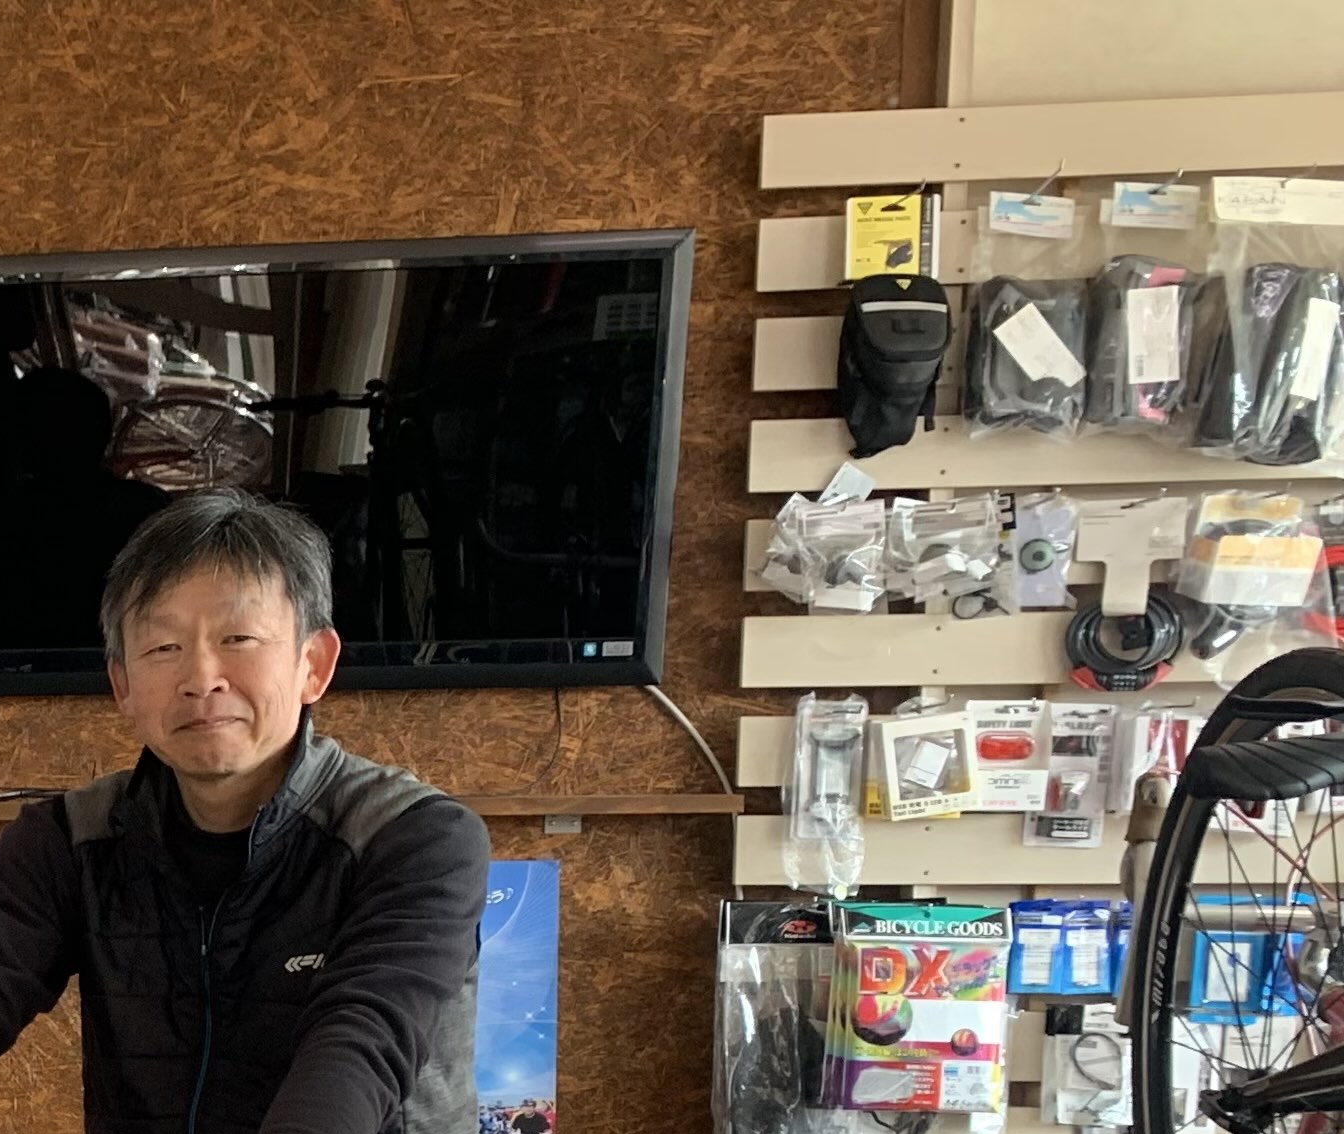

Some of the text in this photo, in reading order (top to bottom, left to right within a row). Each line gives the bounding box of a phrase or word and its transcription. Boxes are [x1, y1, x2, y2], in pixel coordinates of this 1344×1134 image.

[875, 919, 1004, 936] BICYCLE GOODS
[859, 946, 955, 996] DX
